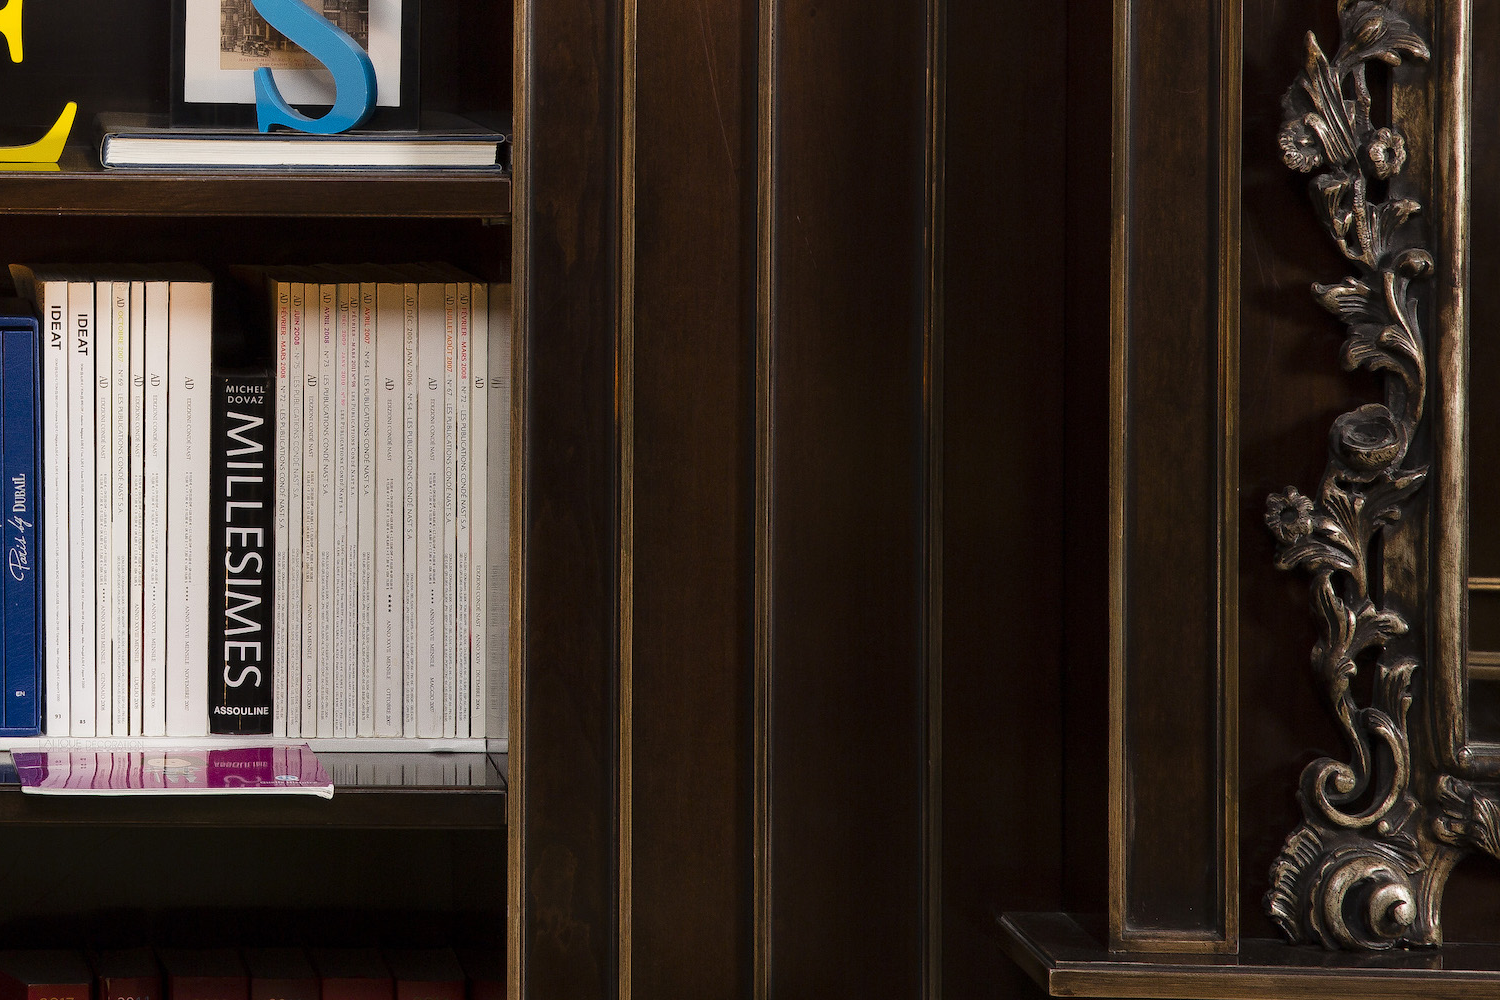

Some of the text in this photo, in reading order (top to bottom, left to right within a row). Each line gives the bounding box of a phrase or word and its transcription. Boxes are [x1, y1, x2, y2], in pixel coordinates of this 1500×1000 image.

[117, 296, 125, 308] AD
[280, 293, 288, 303] AD
[293, 295, 301, 306] AD
[323, 292, 331, 303] AD
[363, 293, 371, 303] AD
[406, 295, 414, 306] AD
[446, 294, 454, 305] AD
[460, 293, 468, 304] AD
[51, 306, 61, 350] IDEAT
[77, 314, 88, 356] IDEAT
[99, 376, 108, 388] AD
[151, 373, 160, 386] AD
[185, 377, 194, 389] AD
[308, 374, 317, 386] AD
[386, 378, 394, 390] AD
[429, 378, 437, 390] AD
[475, 376, 484, 389] AD
[226, 385, 266, 394] MICHEL
[227, 395, 264, 404] DOVAZ
[323, 438, 331, 463] CONDÉ
[363, 438, 371, 463] CONDÉ
[279, 472, 287, 497] CONDÉ
[7, 515, 32, 533] by
[224, 411, 265, 688] MILLESIMES
[8, 535, 30, 581] Paris
[213, 704, 269, 717] ASSOULINE
